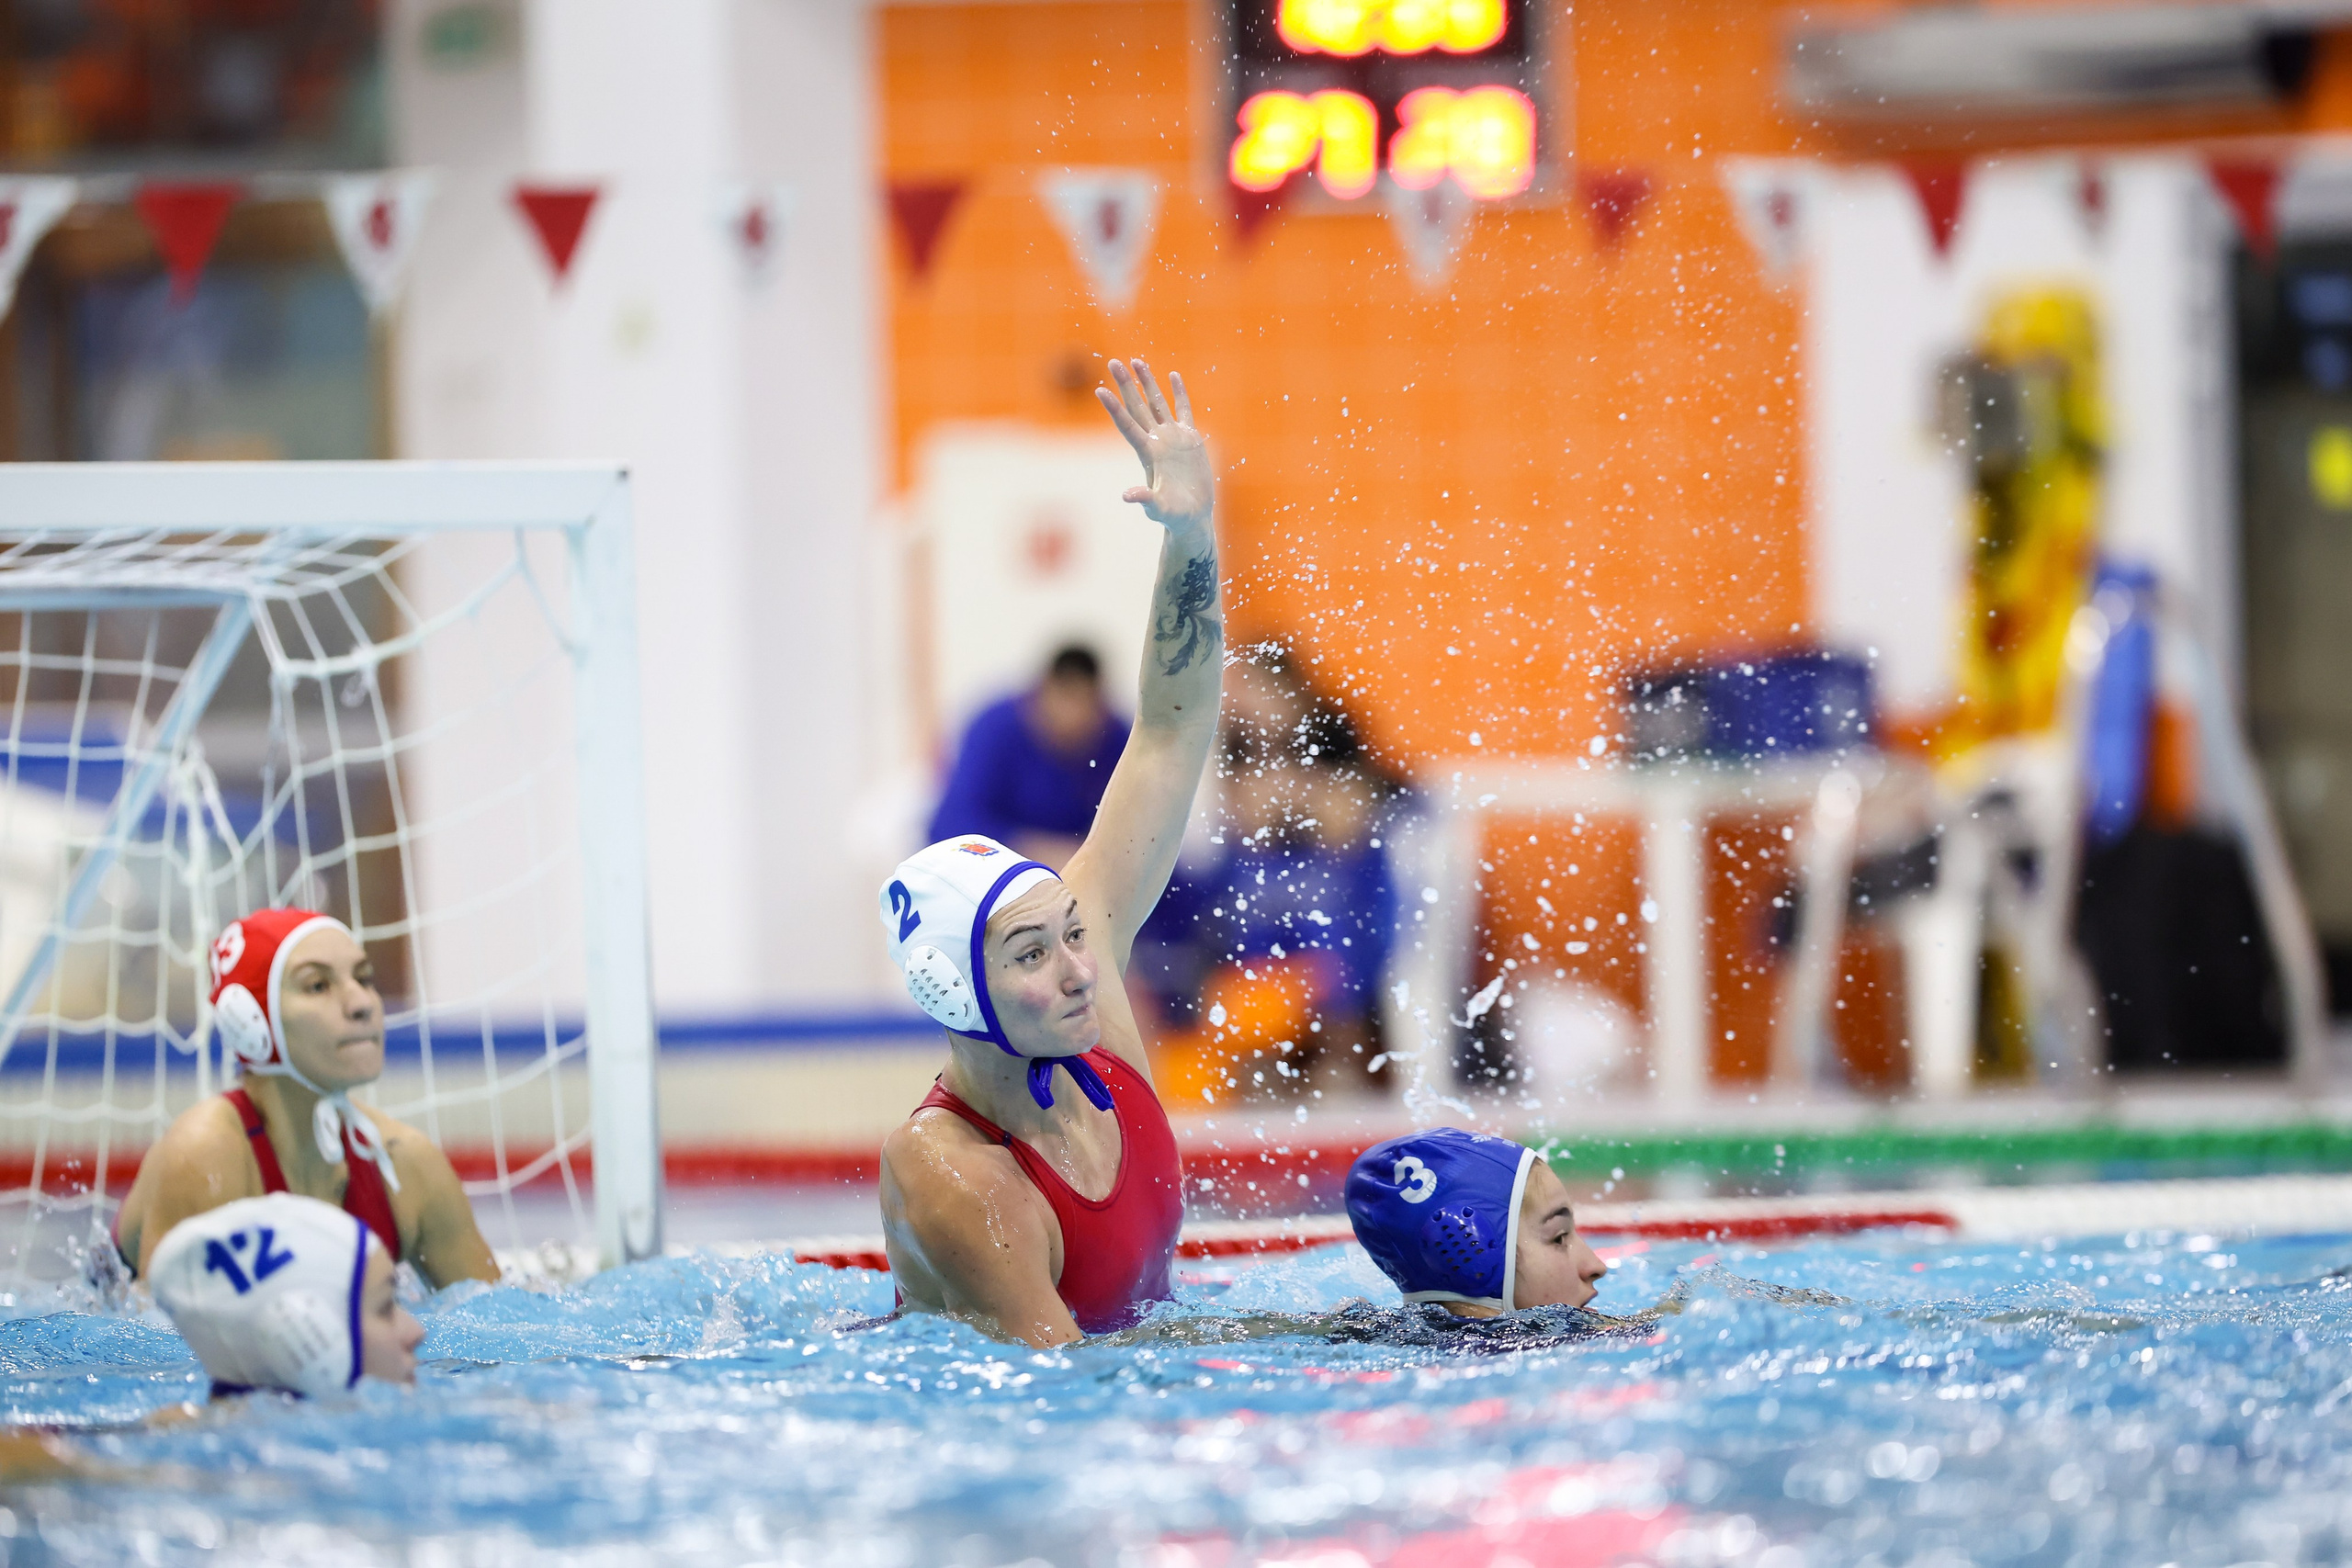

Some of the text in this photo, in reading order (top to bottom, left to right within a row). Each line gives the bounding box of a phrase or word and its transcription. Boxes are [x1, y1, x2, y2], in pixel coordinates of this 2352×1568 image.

[888, 879, 922, 943] 2
[1394, 1156, 1438, 1204] 3
[205, 1226, 294, 1295] 12
